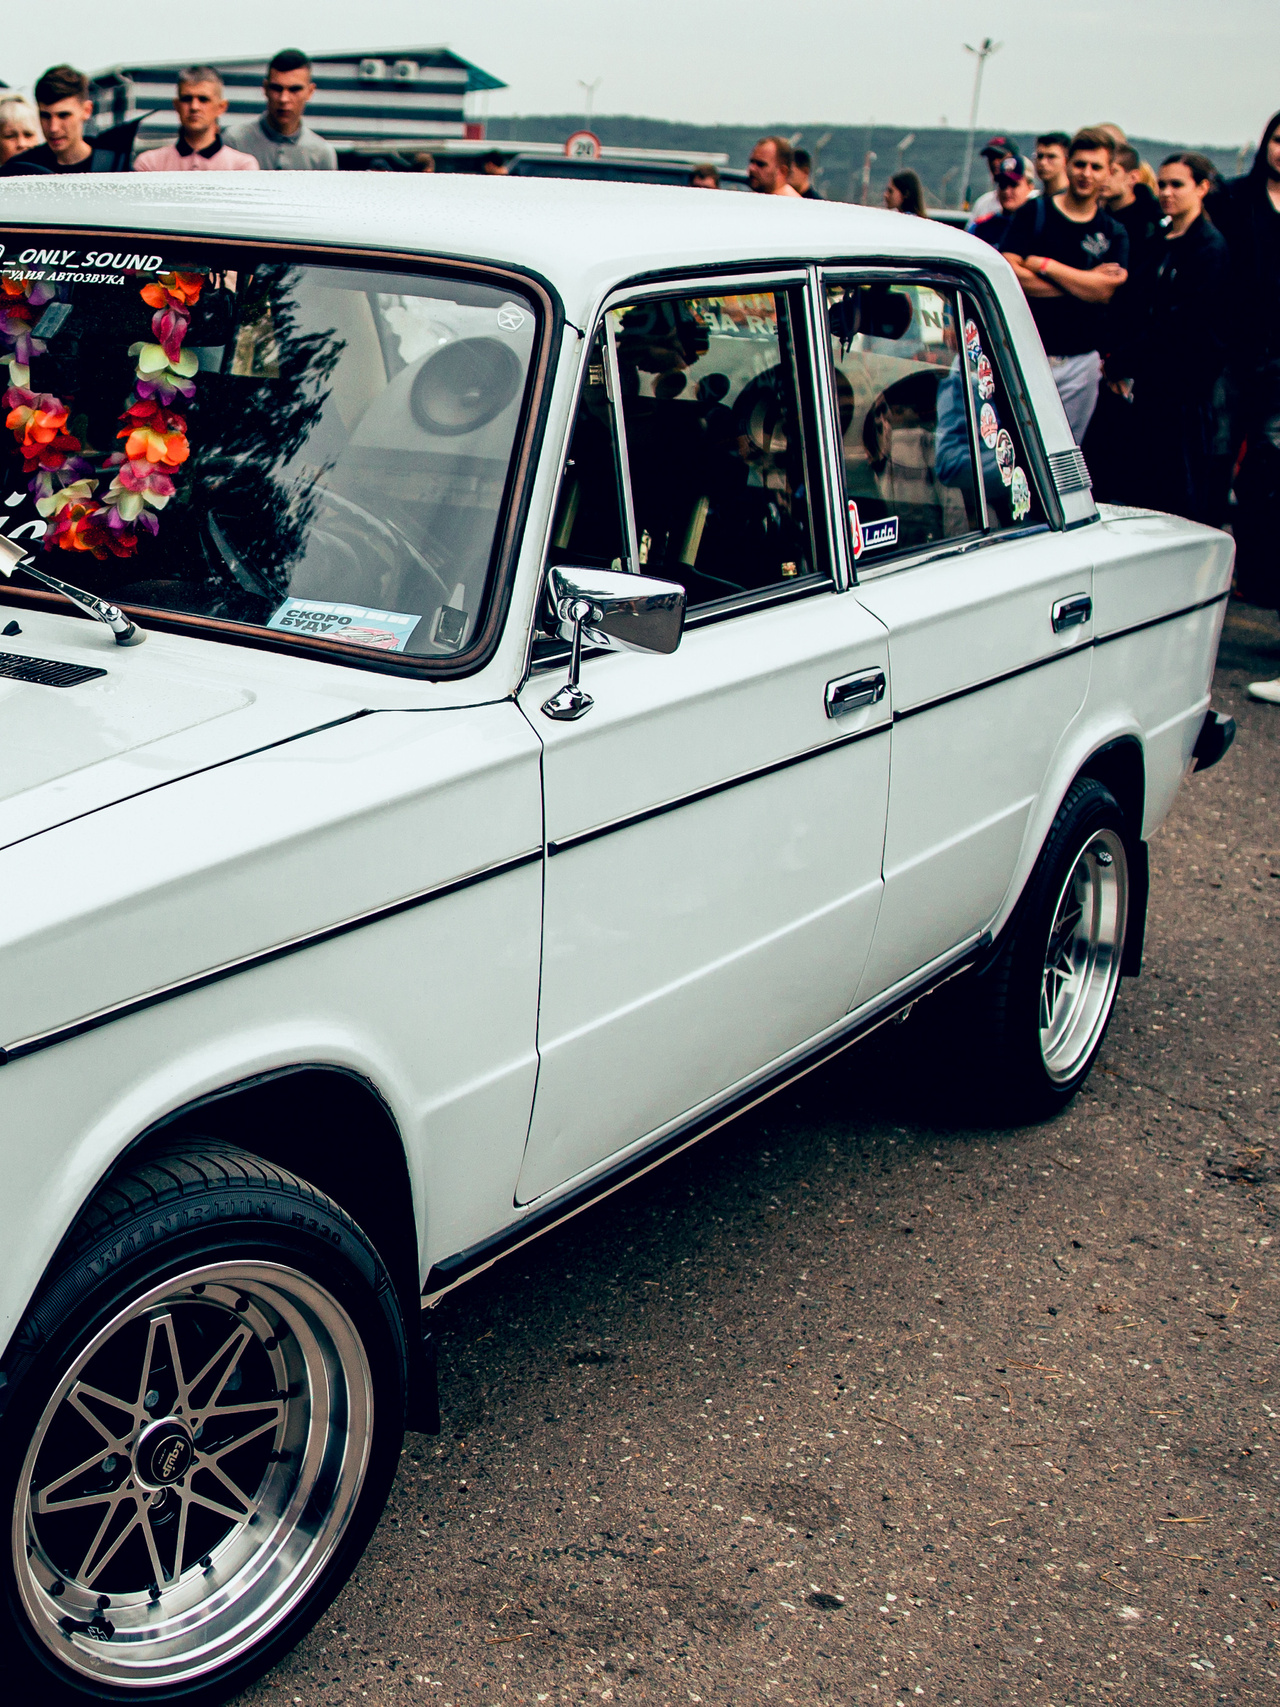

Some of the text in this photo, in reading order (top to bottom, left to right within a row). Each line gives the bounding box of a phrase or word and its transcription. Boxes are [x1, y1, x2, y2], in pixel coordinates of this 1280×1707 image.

[2, 248, 171, 275] _ONLY_SOUND_
[46, 271, 126, 286] АВТОЗВУКА
[864, 523, 896, 546] Lada
[279, 618, 333, 632] БУДУ
[286, 610, 352, 625] СКОРО
[87, 1198, 278, 1277] WINRUN
[162, 1440, 185, 1478] Equip
